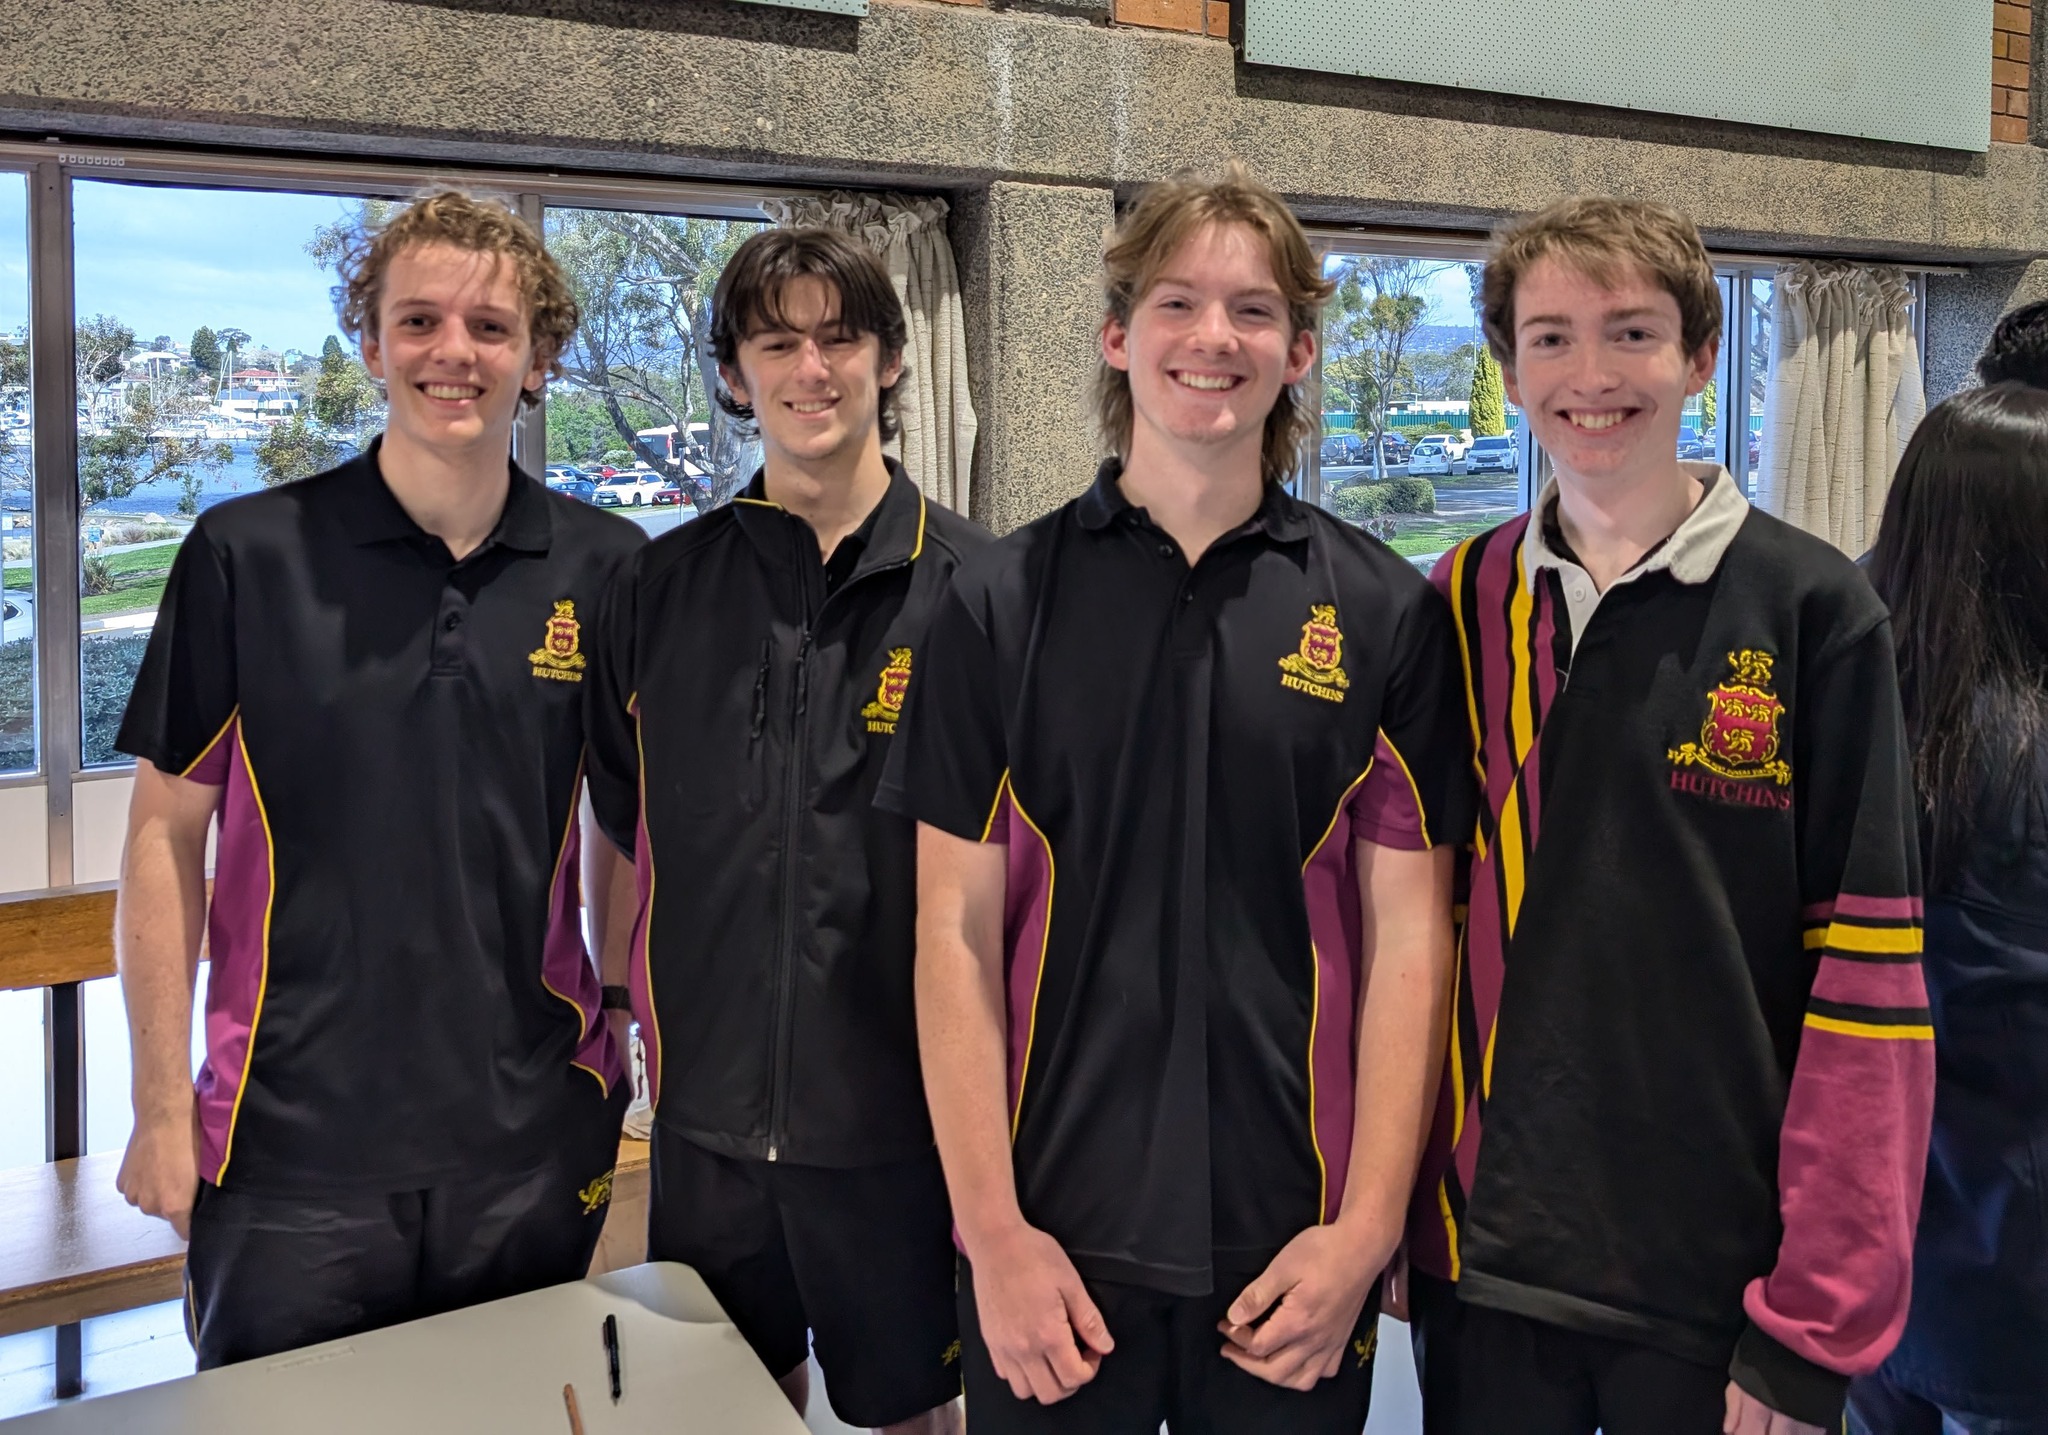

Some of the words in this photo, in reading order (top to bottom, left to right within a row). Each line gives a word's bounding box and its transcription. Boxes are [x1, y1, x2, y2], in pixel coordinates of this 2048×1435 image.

[532, 666, 582, 680] HUTCHINS
[1281, 673, 1344, 703] HUTCHINS
[1670, 770, 1790, 810] HUTCHINS
